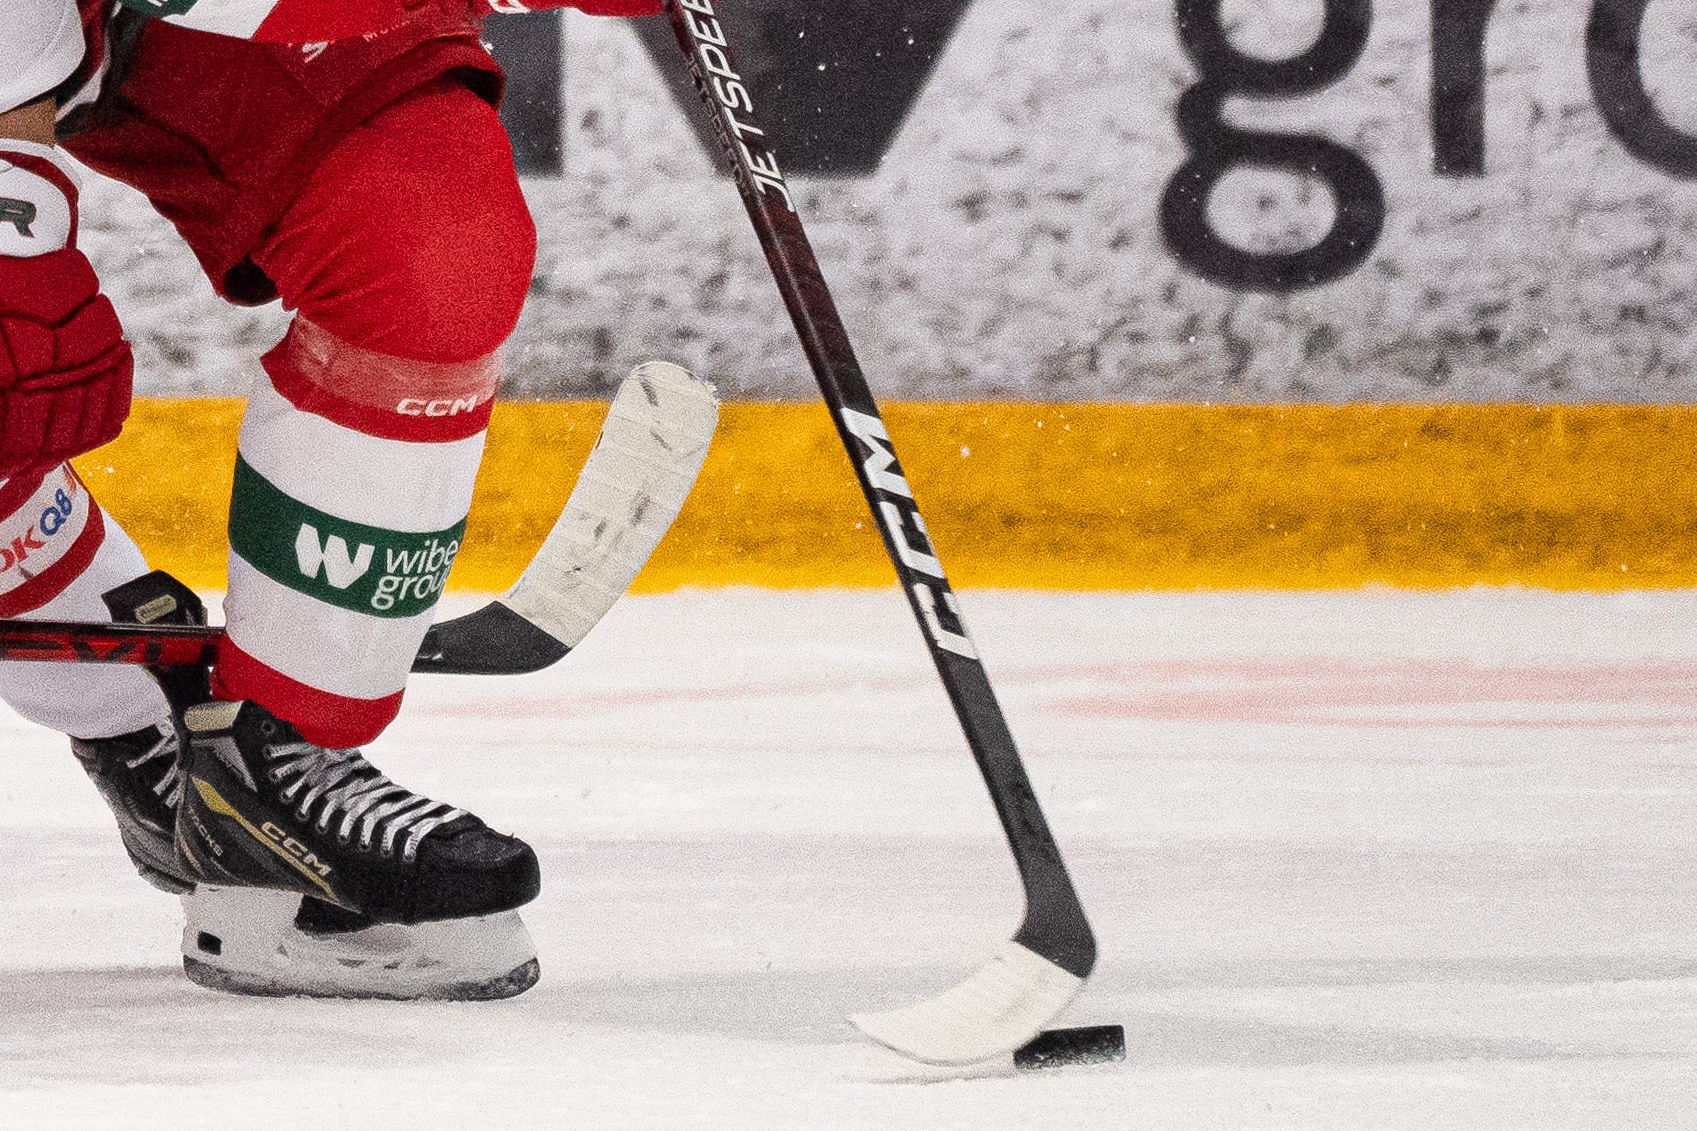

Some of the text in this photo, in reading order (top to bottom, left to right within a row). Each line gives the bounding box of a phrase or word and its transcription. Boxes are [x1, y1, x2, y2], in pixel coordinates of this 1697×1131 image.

[397, 396, 480, 417] CCM
[839, 406, 981, 662] CCM
[259, 819, 334, 878] CCM
